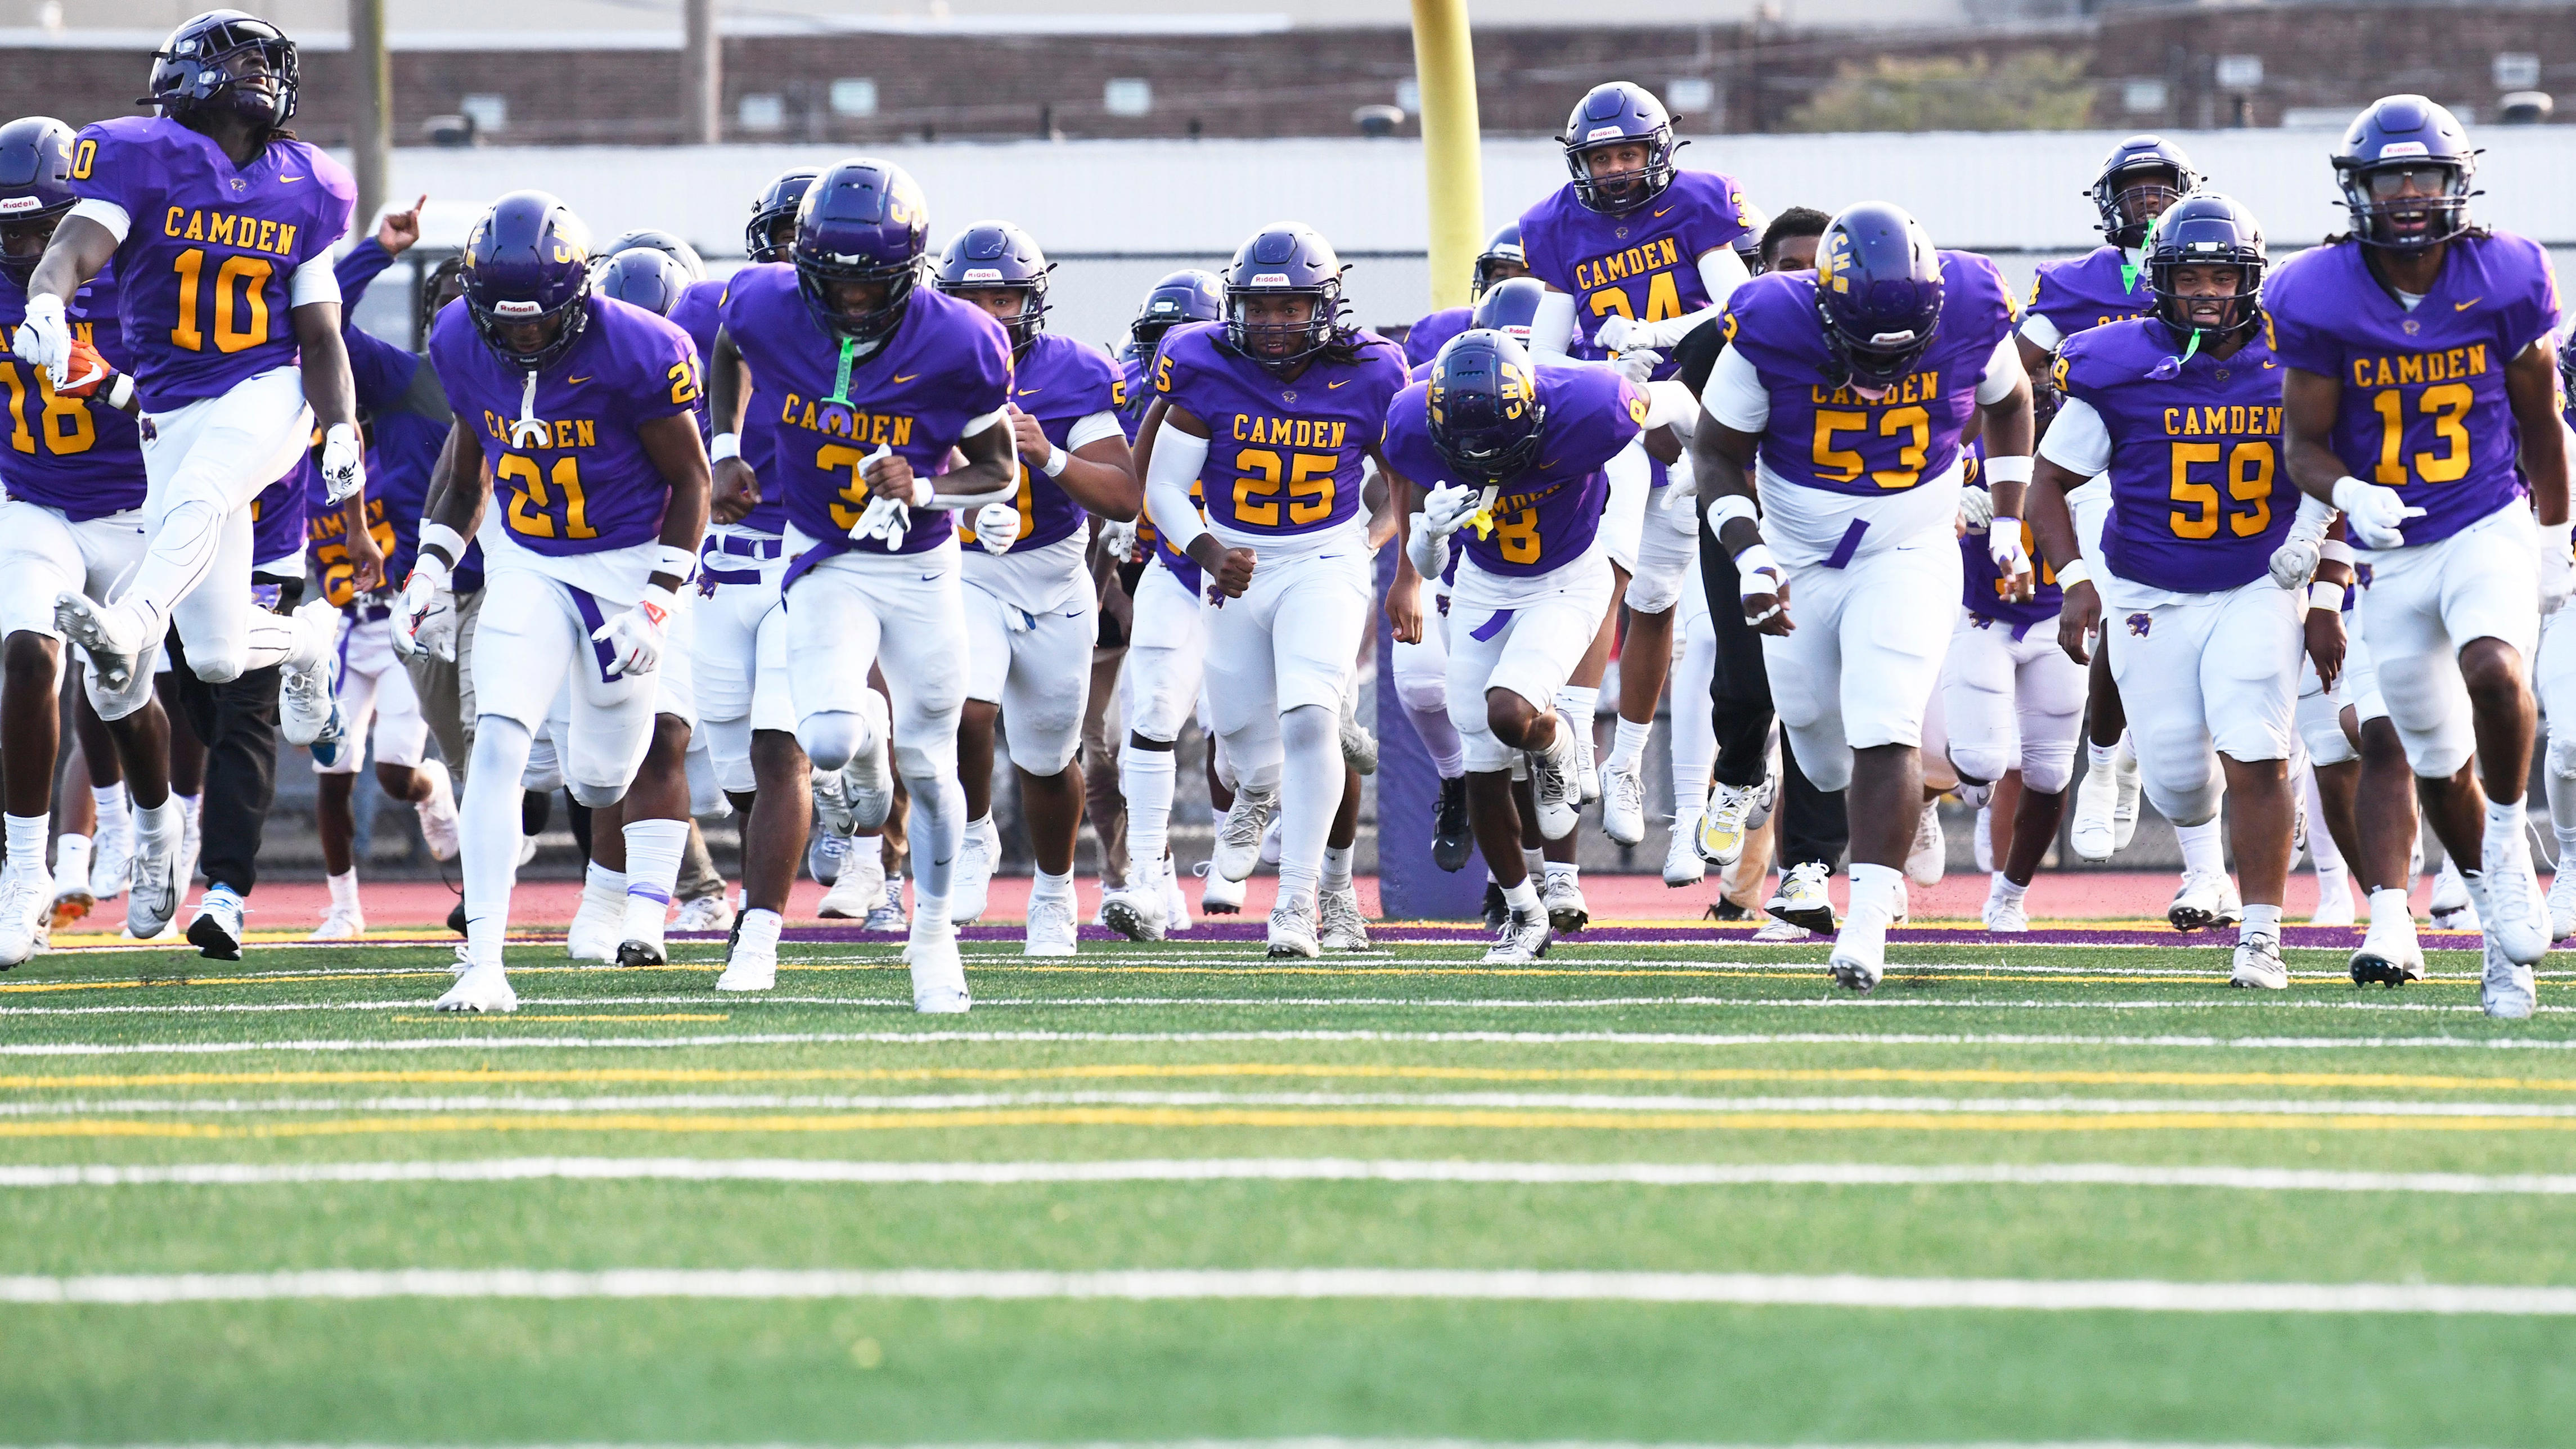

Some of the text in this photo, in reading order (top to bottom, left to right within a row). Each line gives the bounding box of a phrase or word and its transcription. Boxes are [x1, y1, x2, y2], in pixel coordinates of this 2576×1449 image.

[164, 205, 297, 256] CAMDEN
[1576, 237, 1679, 290] CAMDEN
[1830, 233, 1851, 294] CHS
[170, 249, 273, 354] 10
[500, 304, 534, 313] Riddell
[1811, 371, 1939, 406] CADEN
[2354, 343, 2487, 388] CAMDEN
[484, 410, 595, 449] CADEN
[1233, 413, 1346, 448] CAMDEN
[1812, 405, 1930, 489] 53
[2164, 406, 2283, 436] CAMDEN
[2373, 382, 2472, 485] 13
[497, 452, 597, 538] 21
[816, 443, 869, 529] 3
[1233, 448, 1338, 525] 25
[2170, 441, 2274, 539] 59
[1492, 507, 1541, 565] 8
